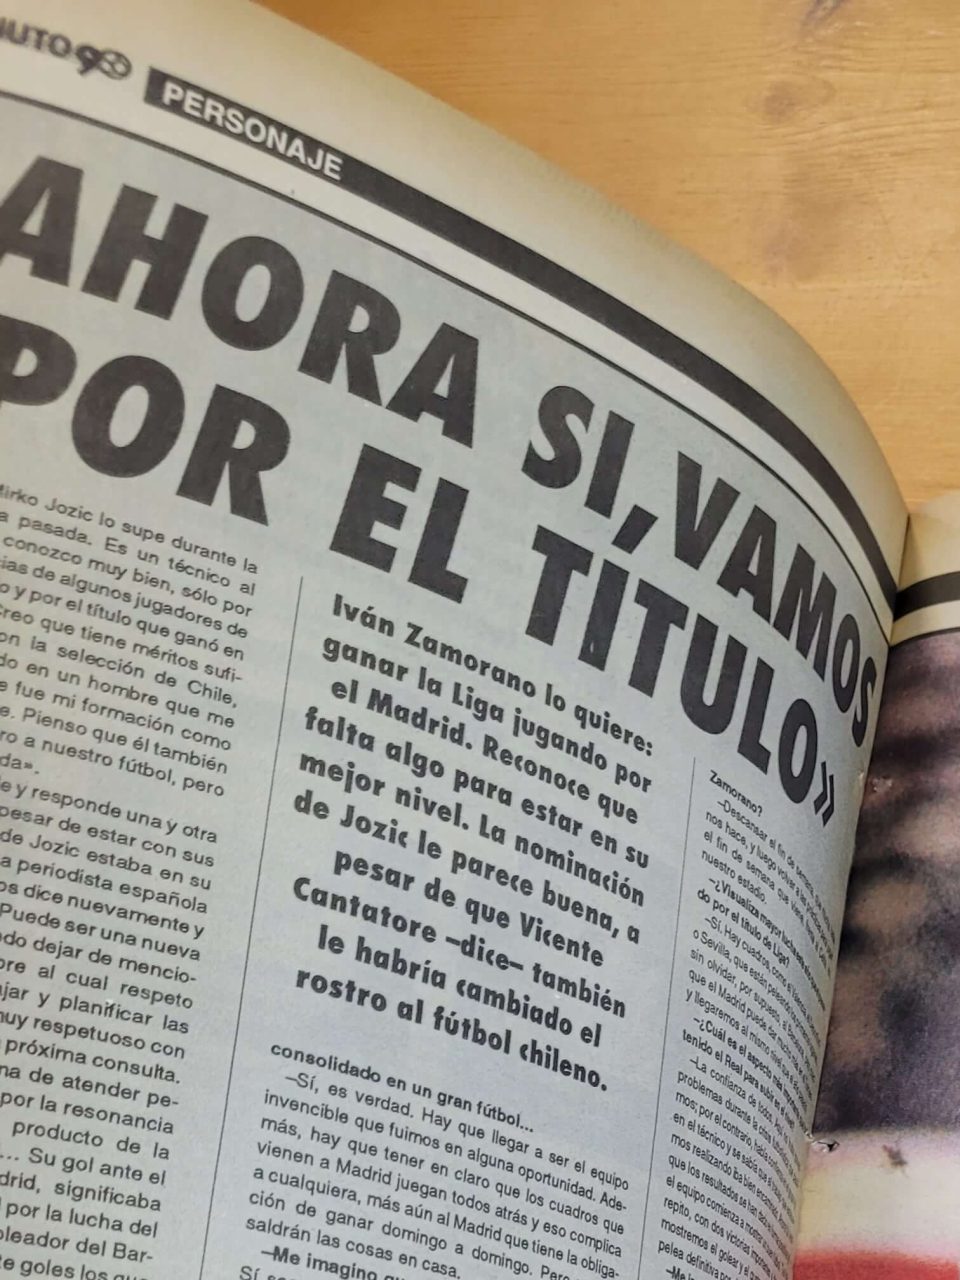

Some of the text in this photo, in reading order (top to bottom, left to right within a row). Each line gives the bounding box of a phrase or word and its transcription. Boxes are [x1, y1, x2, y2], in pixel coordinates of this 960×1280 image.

[162, 80, 344, 181] PERSONAJE
[0, 155, 480, 449] AHORA
[0, 314, 291, 527] POR
[329, 442, 471, 605] EL
[3, 536, 253, 617] conozco muy bien, sólo por
[321, 637, 653, 793] ganar la Liga jugando por
[332, 593, 653, 757] Iván Zamorano lo quiere:
[22, 707, 228, 775] Pienso que él también
[305, 705, 649, 869] falta algo para estar en su
[331, 679, 639, 825] el Madrid. Reconoce que
[293, 789, 641, 945] de Jozic le parece buena, a
[299, 753, 645, 907] mejor nivel. La nominación
[0, 902, 201, 962] Puede ser una nueva
[293, 876, 437, 943] Cantatore
[531, 961, 626, 1019] también
[333, 850, 605, 967] pesar de que Vicente
[295, 969, 608, 1093] rostro al fútbol chileno.
[317, 923, 603, 1049] le habría cambiado el
[4, 1039, 181, 1085] próxima consulta.
[269, 1043, 381, 1083] consolidado
[385, 1075, 407, 1092] en
[411, 1083, 433, 1099] un
[436, 1091, 473, 1113] gran
[11, 1121, 170, 1161] producto de la
[327, 1084, 348, 1099] es
[355, 1090, 415, 1119] verdad.
[421, 1107, 453, 1132] Hay
[457, 1121, 485, 1139] que
[491, 1129, 531, 1155] llegar
[534, 1147, 543, 1159] a
[548, 1152, 571, 1168] ser
[573, 1159, 587, 1175] el
[589, 1167, 629, 1191] equipo
